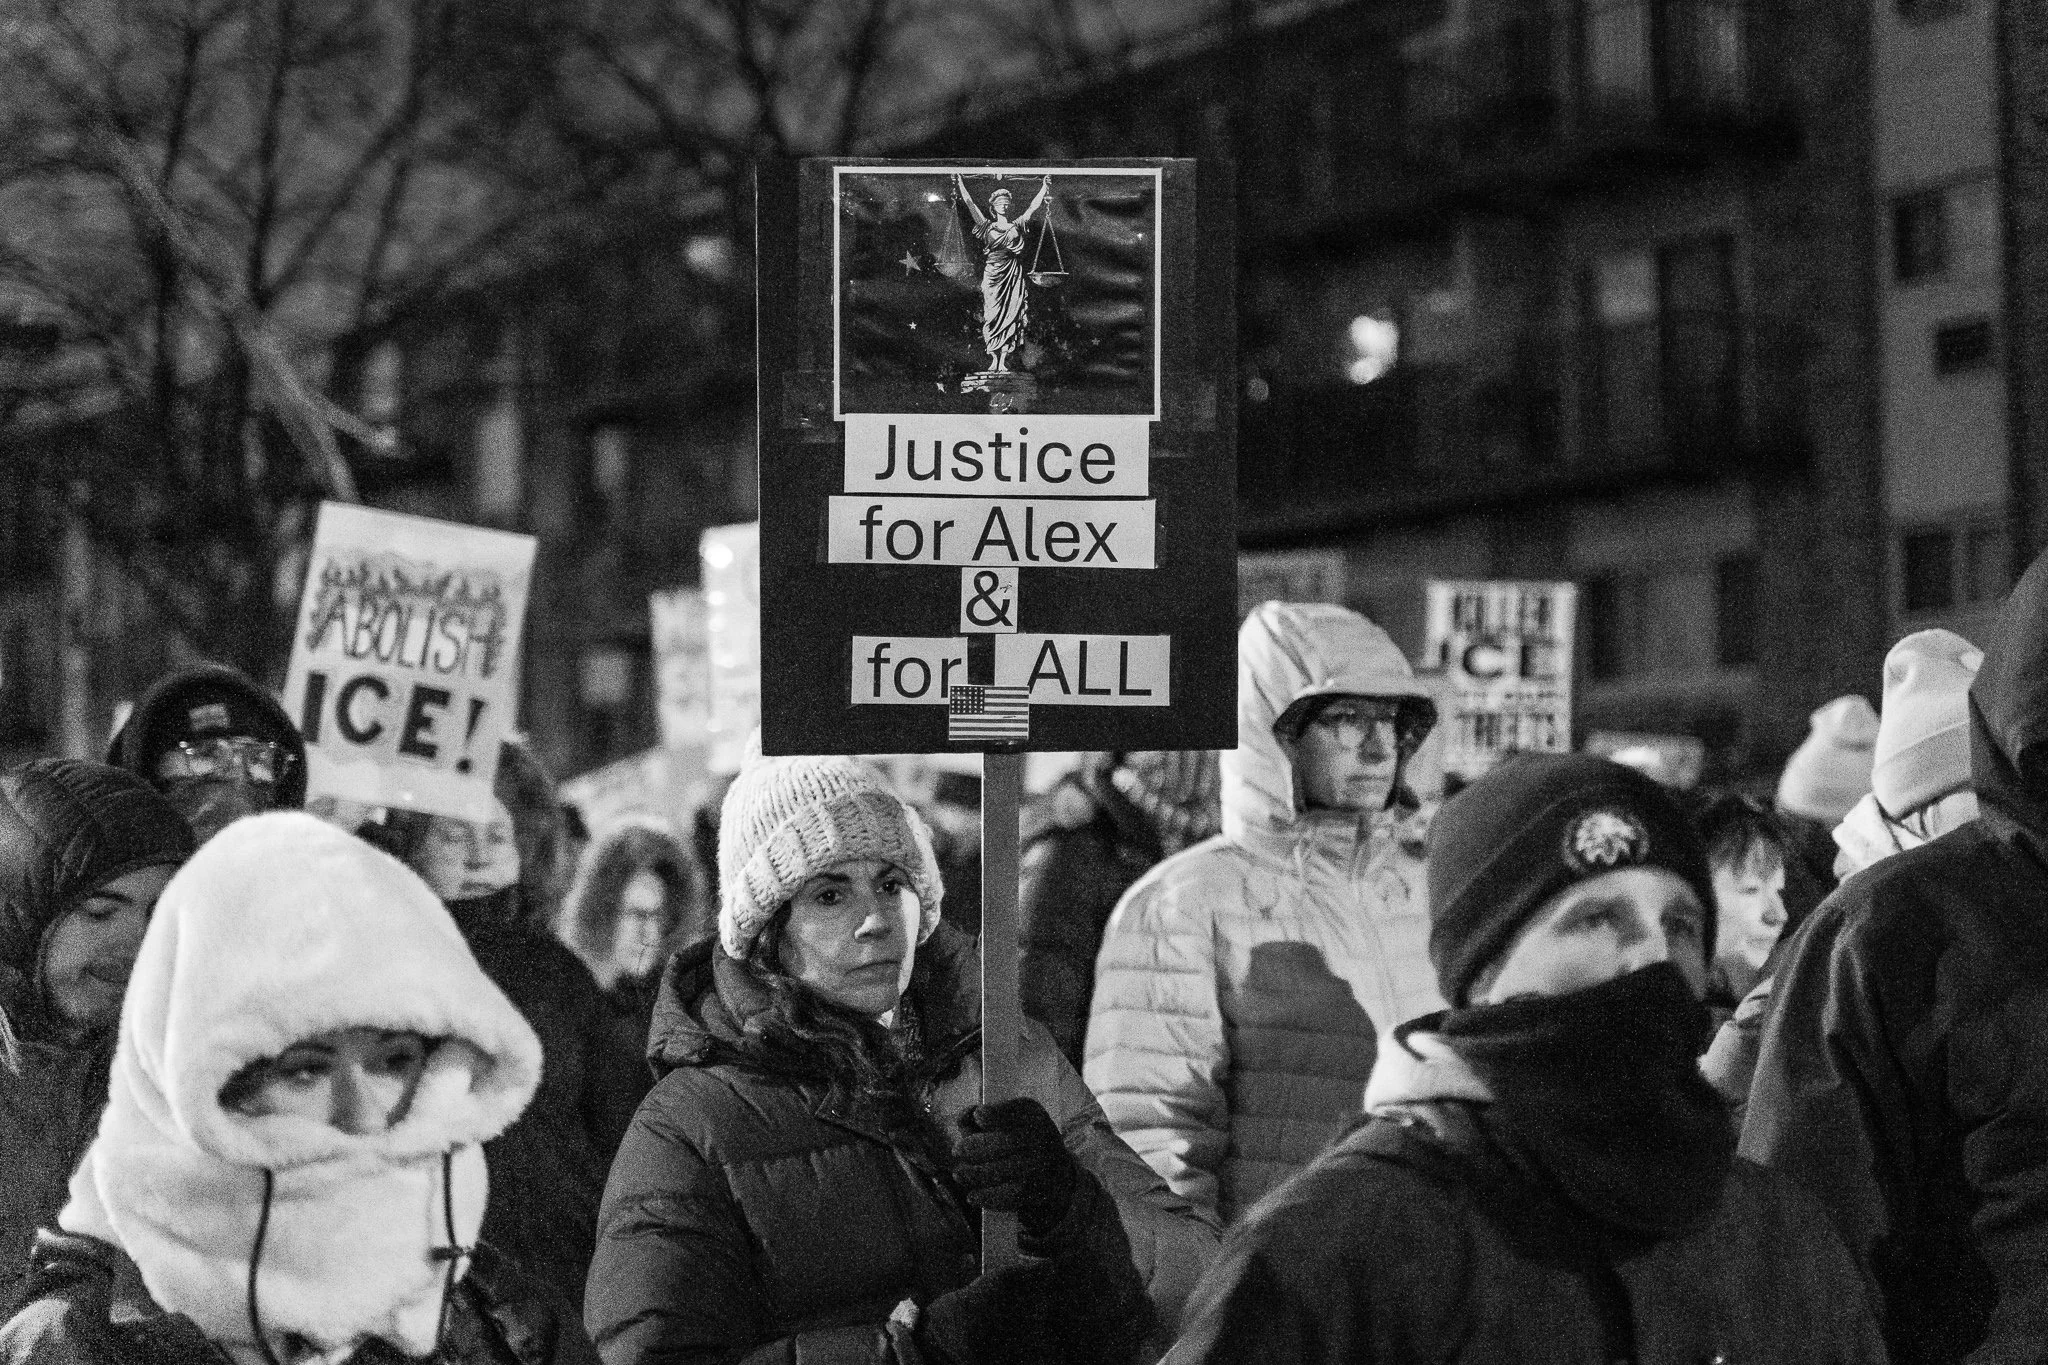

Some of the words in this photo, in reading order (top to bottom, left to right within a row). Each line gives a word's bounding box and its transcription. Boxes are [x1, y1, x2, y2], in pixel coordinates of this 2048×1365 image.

[875, 424, 1116, 485] Justice
[859, 504, 954, 561] for
[971, 506, 1119, 563] Alex
[965, 570, 1014, 627] &
[306, 590, 503, 680] ABOLISH
[867, 642, 962, 698] for
[1028, 639, 1152, 697] ALL
[302, 670, 487, 774] ICE!
